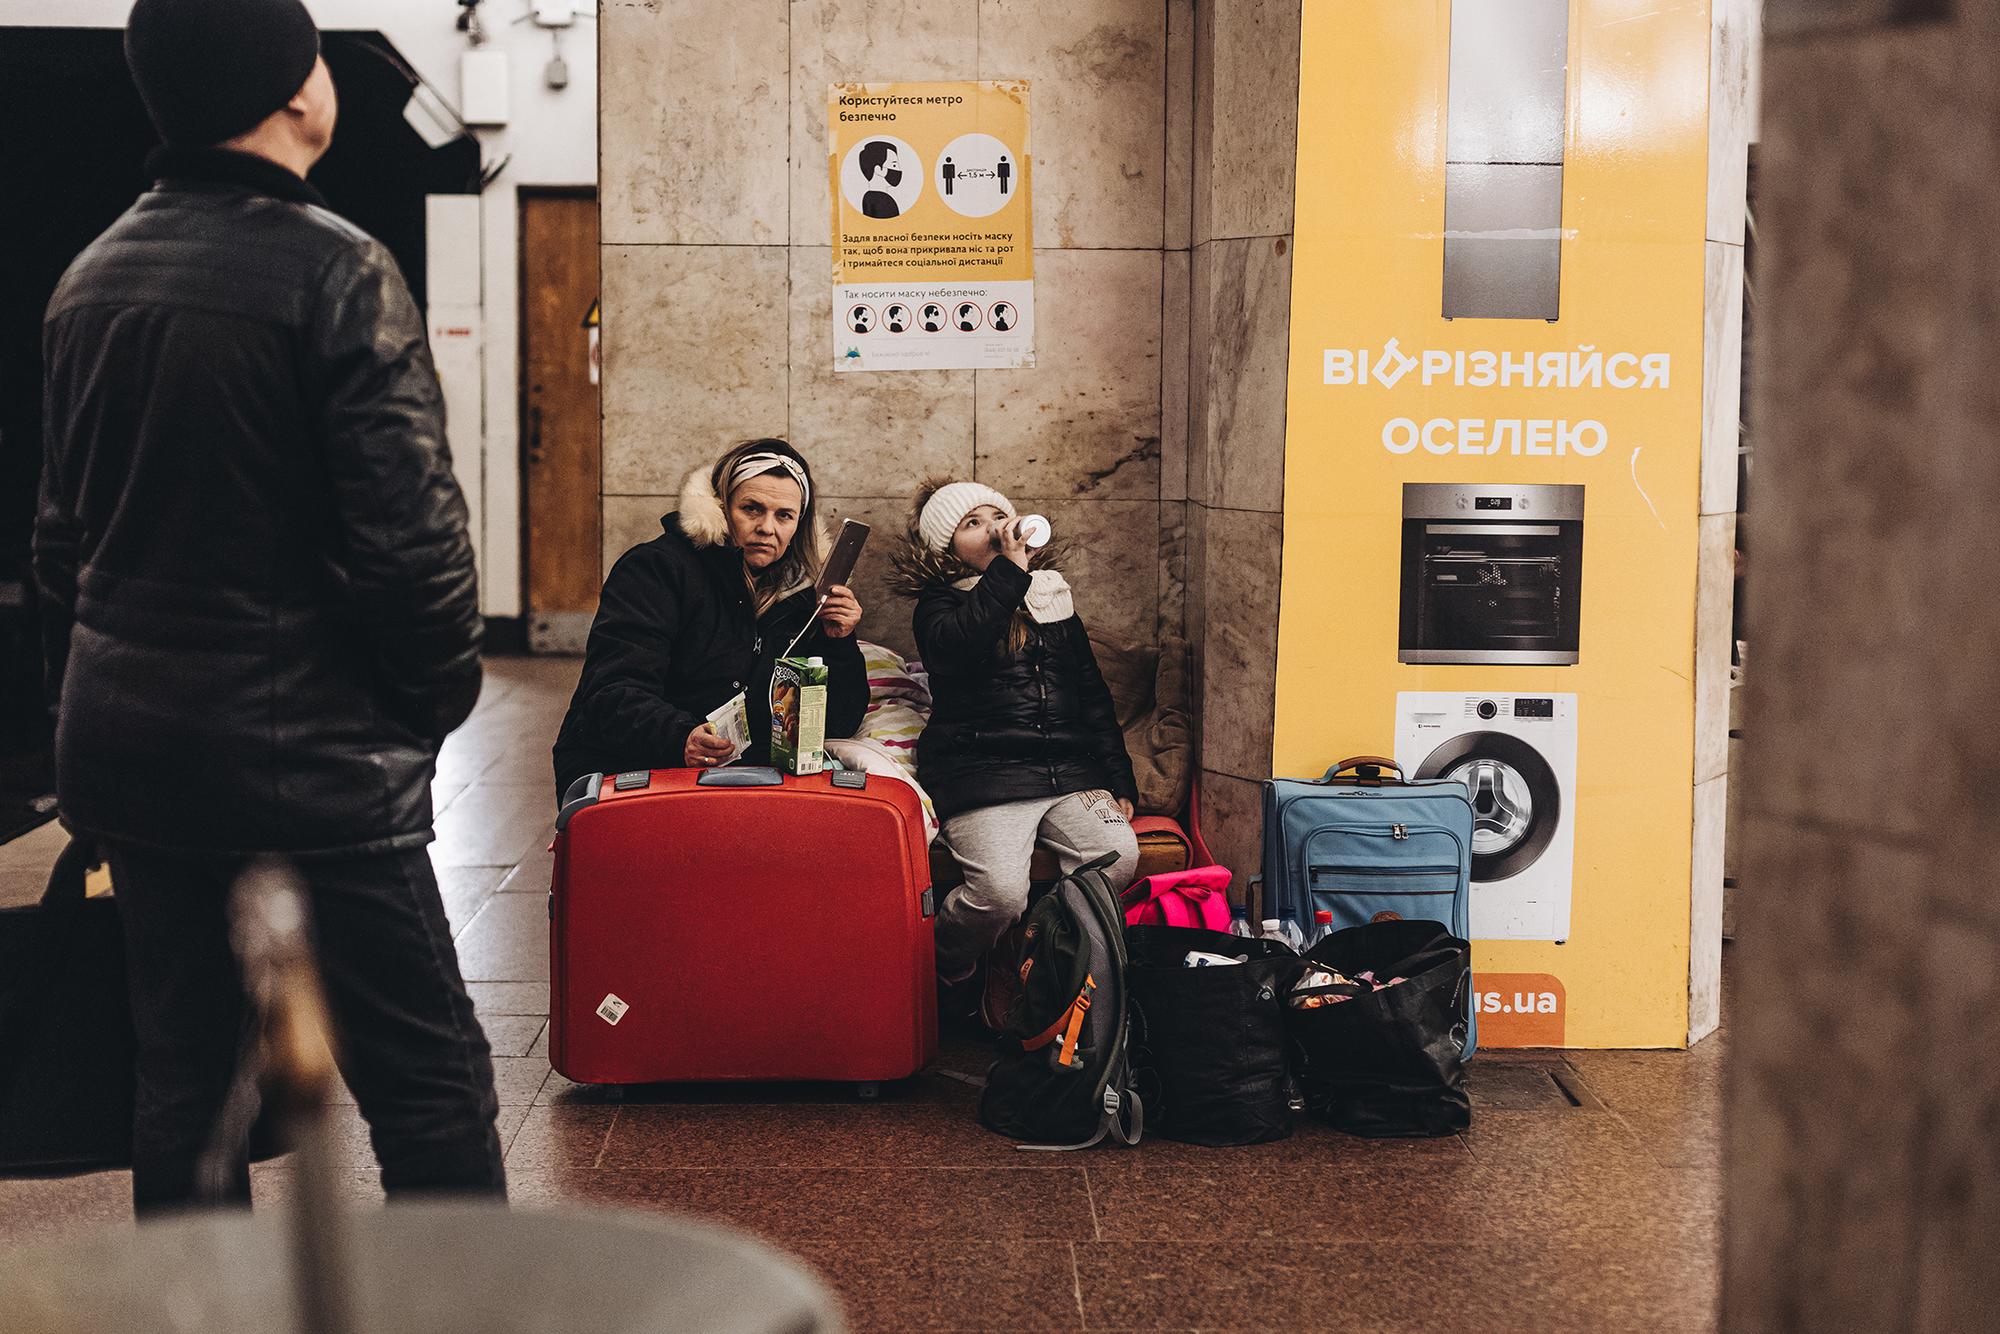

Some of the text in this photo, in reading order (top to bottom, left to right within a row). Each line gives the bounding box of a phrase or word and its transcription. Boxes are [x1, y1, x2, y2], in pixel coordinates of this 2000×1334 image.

[839, 95, 963, 108] Користуйтеся метро
[839, 111, 897, 122] безпечно
[842, 232, 1013, 243] Задля власної безпеки носіть маску
[863, 246, 883, 255] щоб
[910, 246, 967, 256] прикривала
[969, 245, 983, 253] ніс
[998, 245, 1014, 255] рот
[848, 259, 903, 269] тримайтеся
[906, 257, 957, 268] соціальної
[959, 257, 1003, 266] дистанції
[844, 288, 988, 299] Так носити маску небезпечно:
[1382, 417, 1608, 457] ОСЕЛЕЮ
